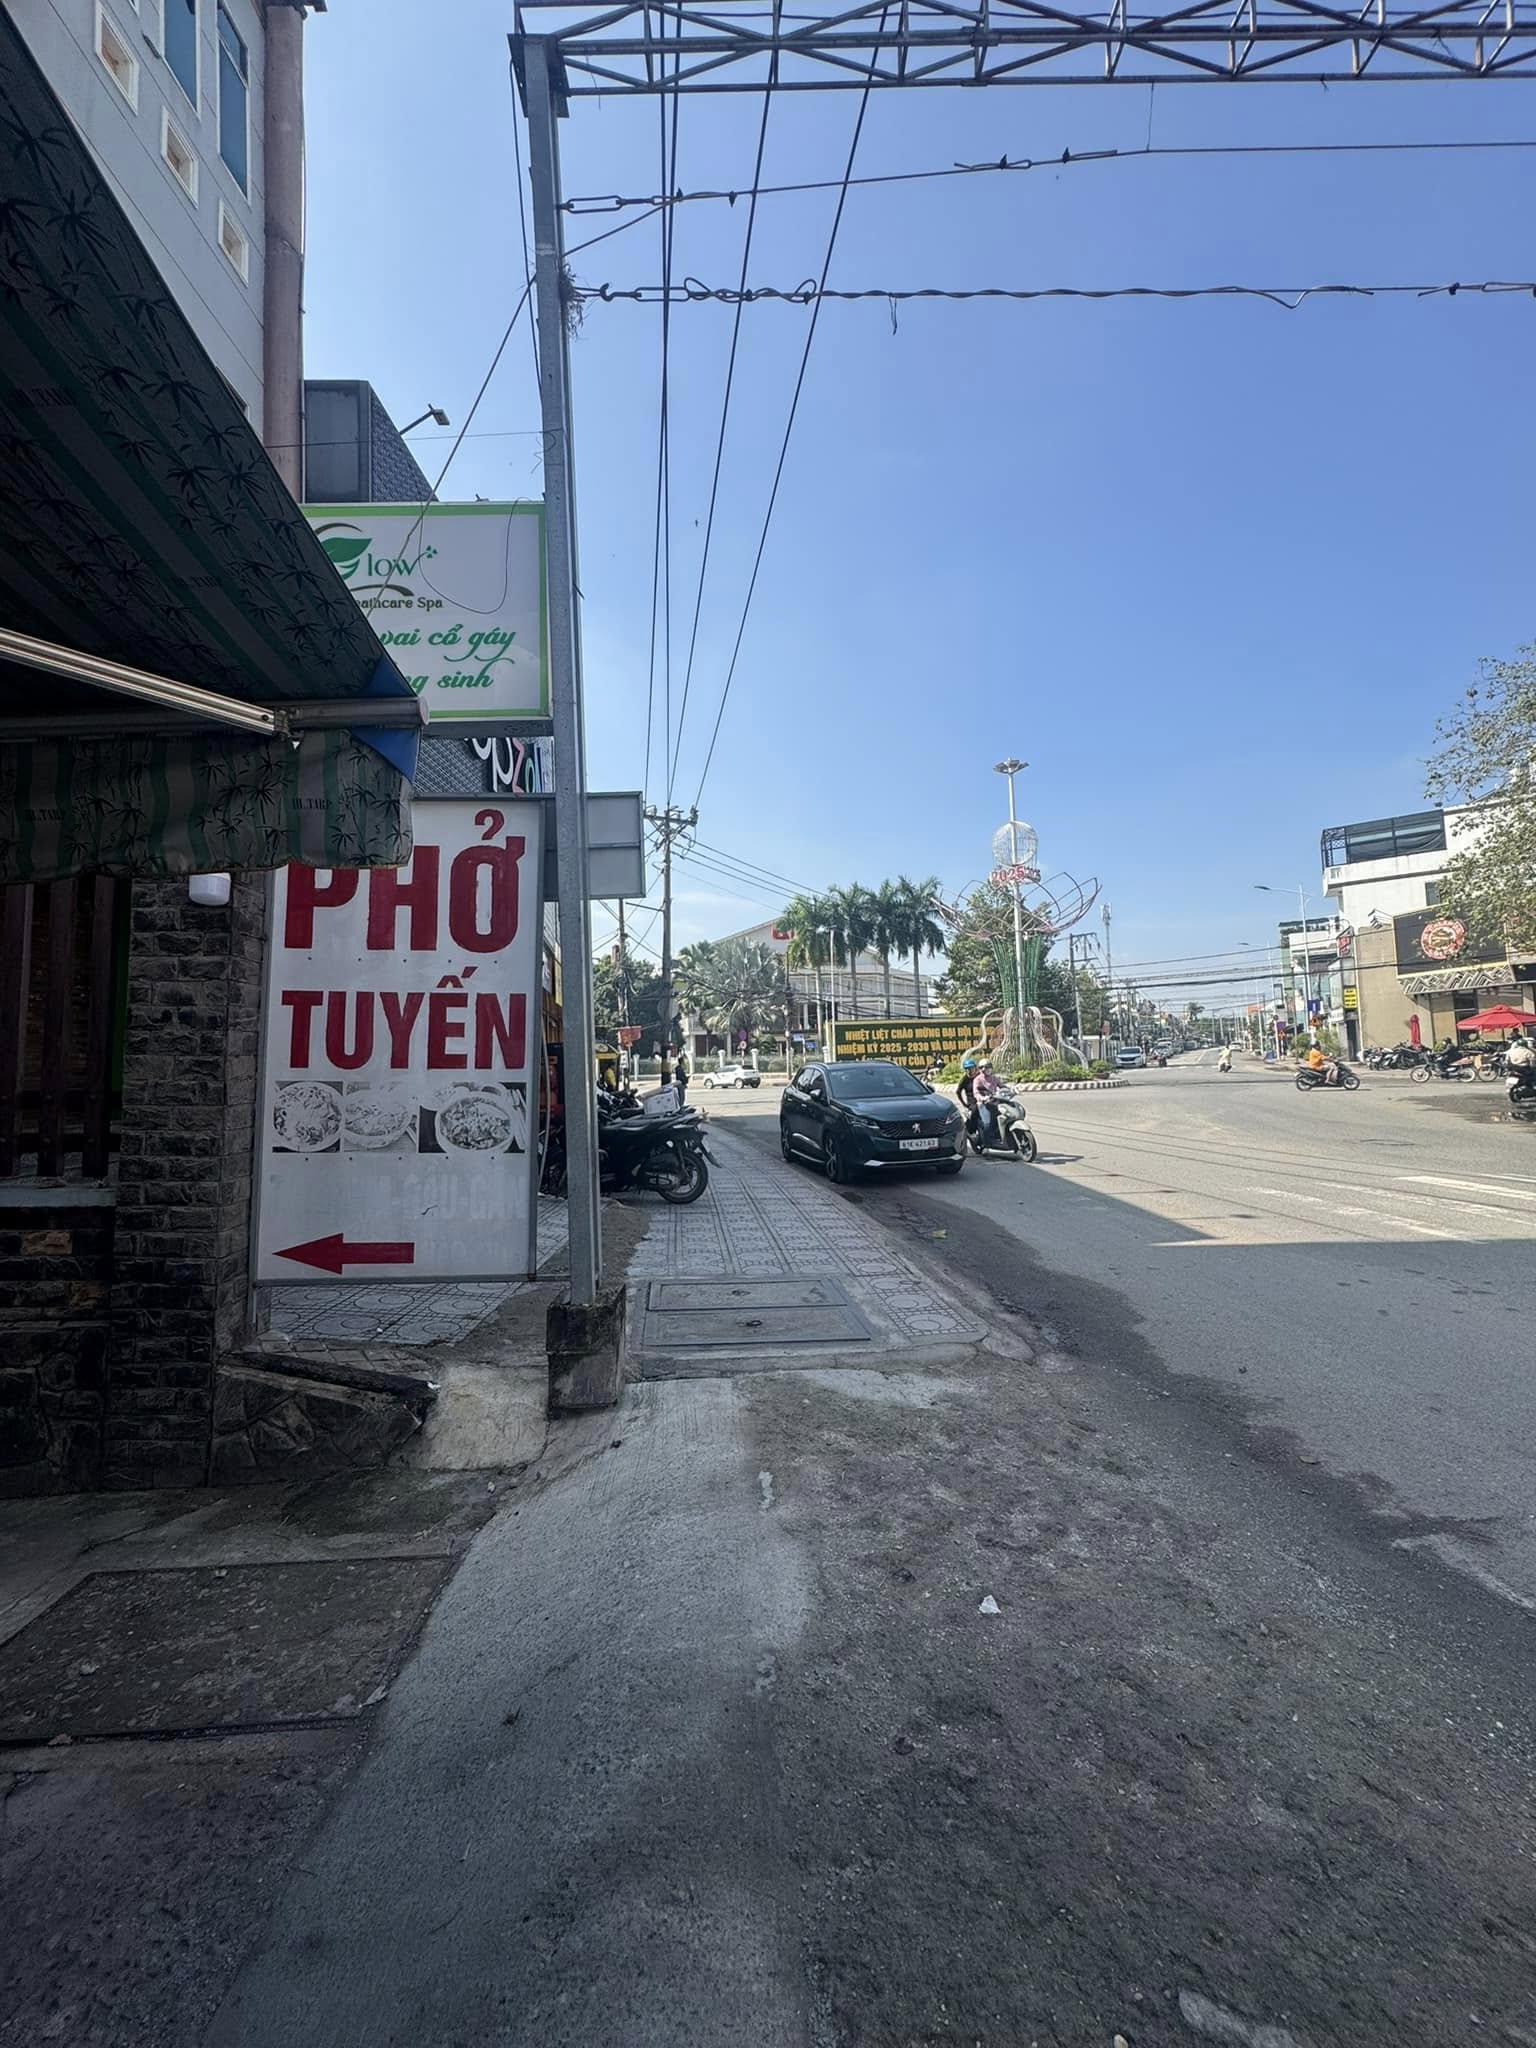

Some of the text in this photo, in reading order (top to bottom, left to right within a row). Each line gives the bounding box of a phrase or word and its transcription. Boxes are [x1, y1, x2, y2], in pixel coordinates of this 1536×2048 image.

[417, 597, 443, 612] Spa
[428, 623, 465, 646] cổ
[443, 627, 516, 662] gáy
[437, 657, 515, 688] sinh
[284, 809, 526, 953] PHỞ
[282, 966, 527, 1070] TUYẾN
[845, 1028, 870, 1041] NHIỆT
[872, 1028, 889, 1040] LIỆT
[891, 1026, 914, 1039] CHÀO
[915, 1025, 941, 1038] MỪNG
[837, 1043, 866, 1057] NHIỆM
[880, 1041, 902, 1053] 2025
[908, 1040, 930, 1052] 2030
[931, 1039, 943, 1051] VÀ
[908, 1054, 926, 1066] CỦA
